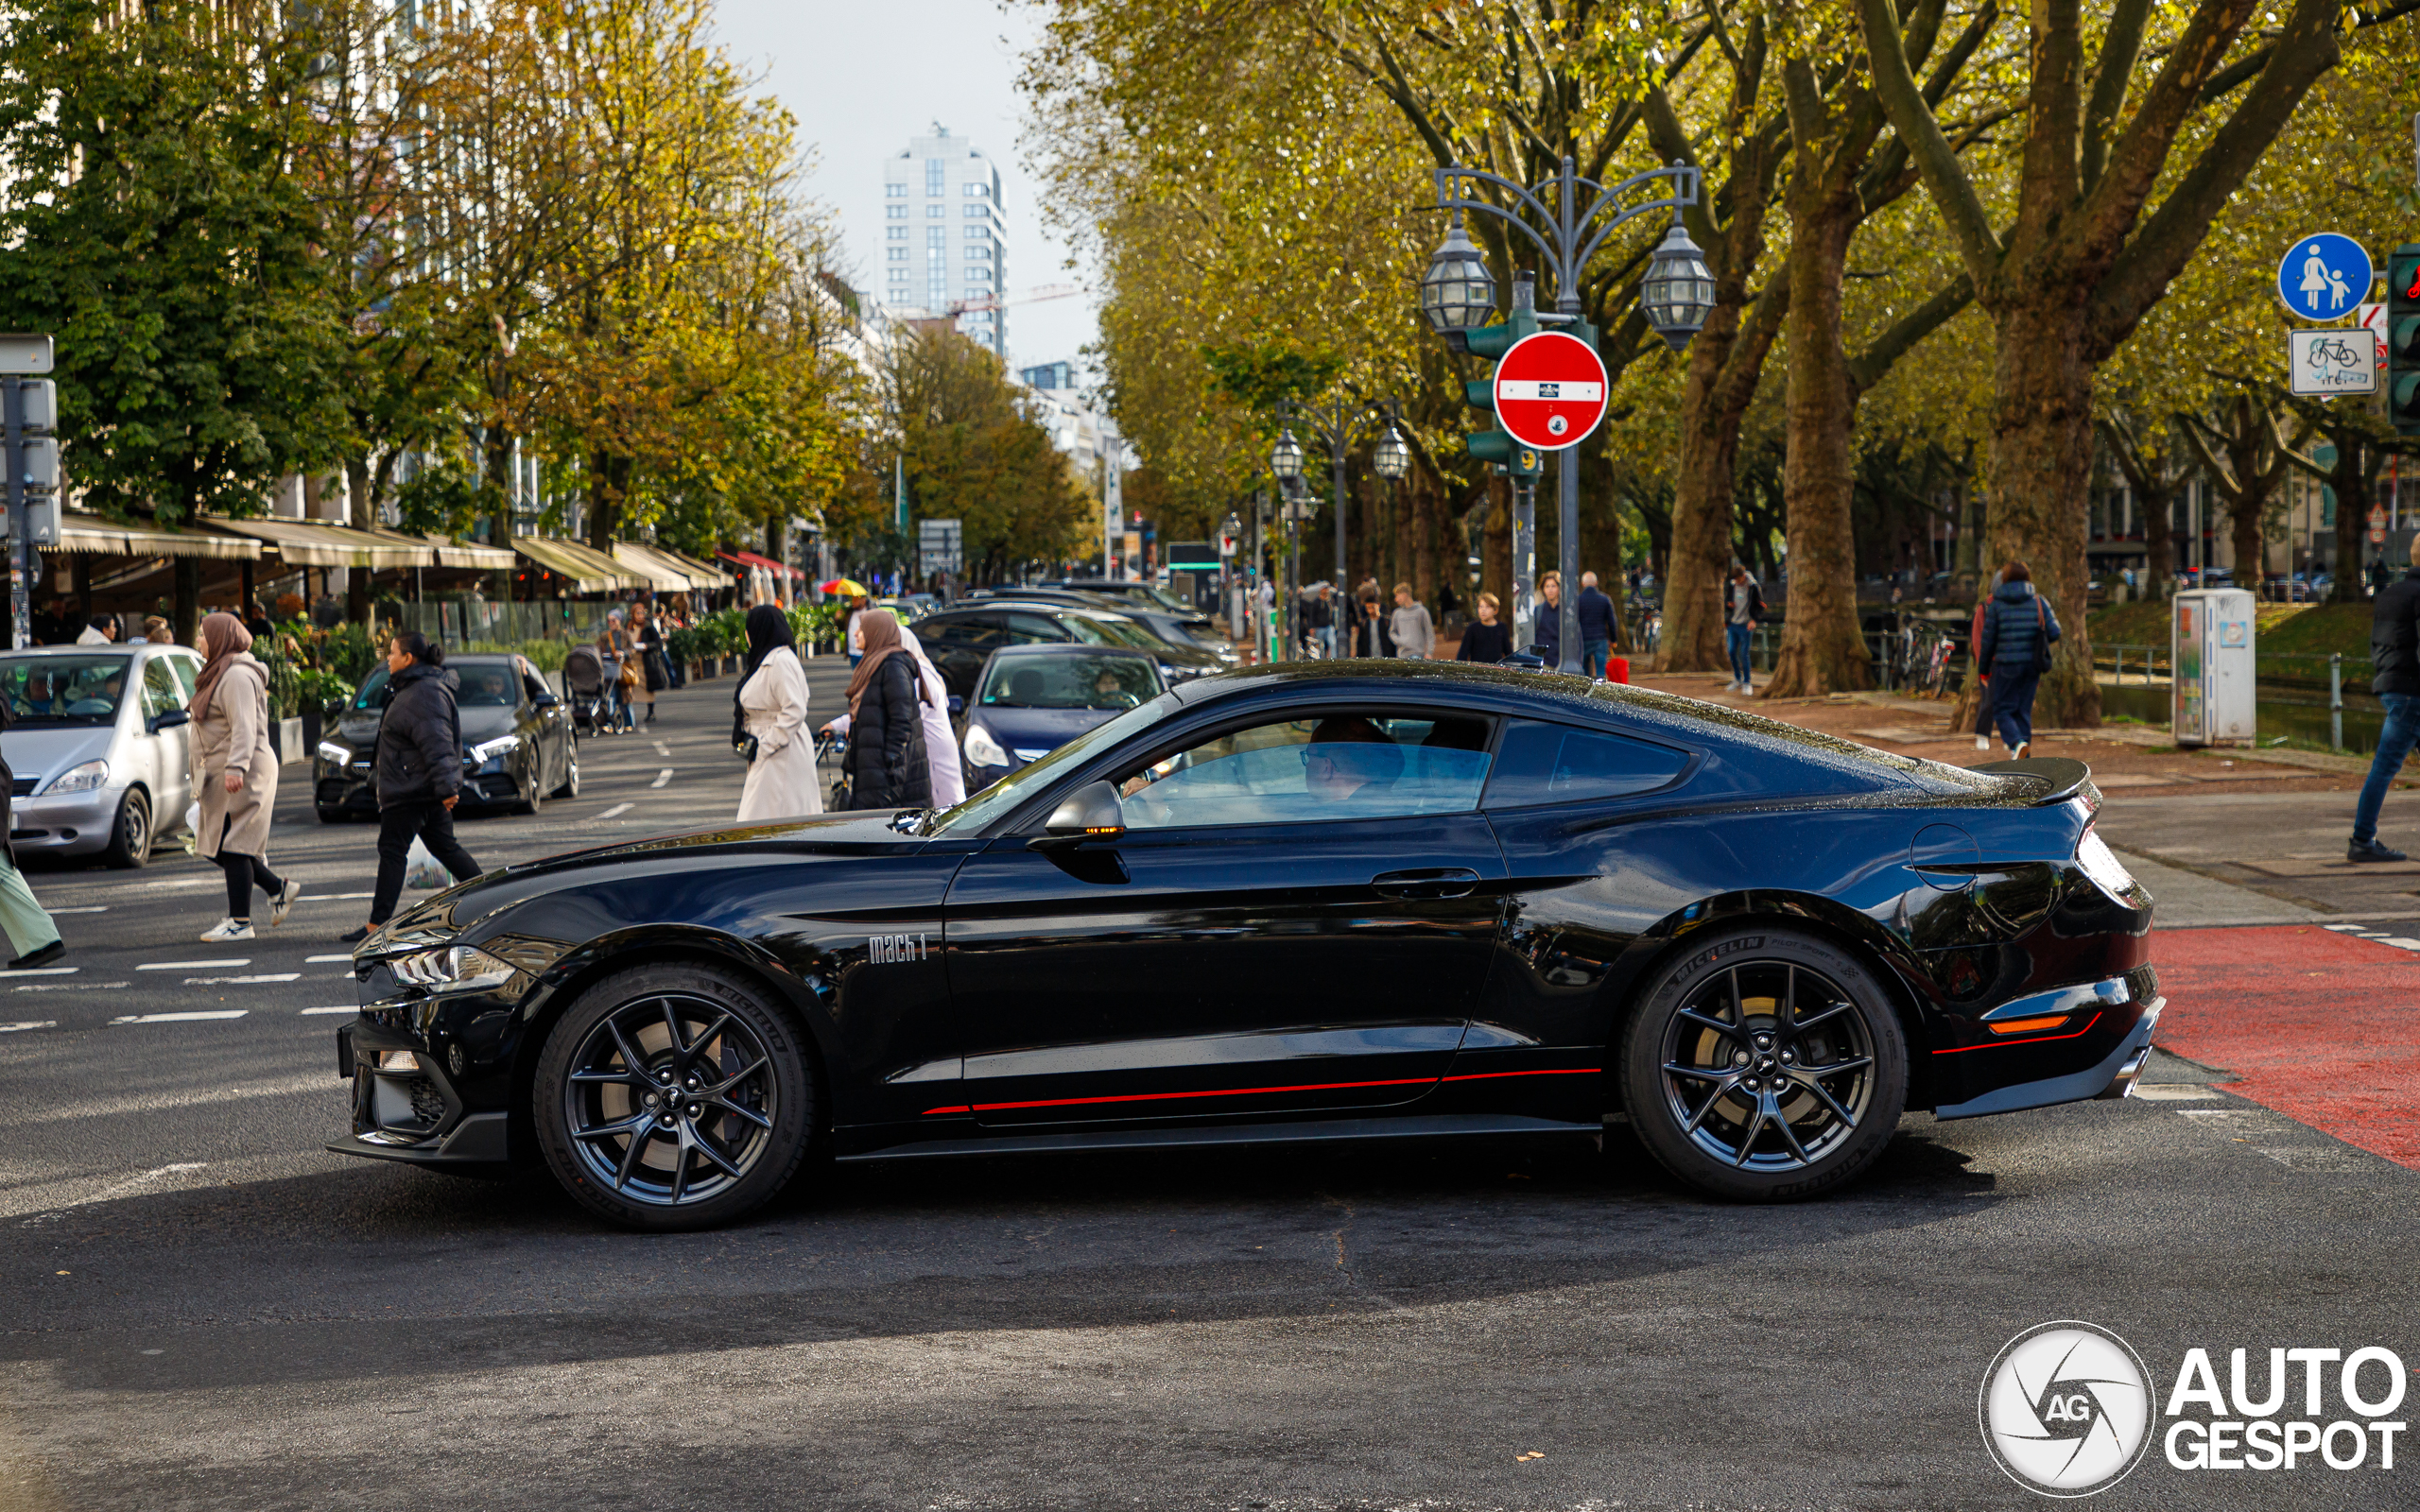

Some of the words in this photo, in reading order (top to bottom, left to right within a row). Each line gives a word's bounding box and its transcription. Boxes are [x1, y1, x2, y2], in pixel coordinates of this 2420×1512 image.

[920, 933, 926, 960] 1
[1675, 936, 1761, 984] MICHELIN
[1771, 938, 1799, 947] PILOT
[719, 987, 785, 1049] MICHELIN
